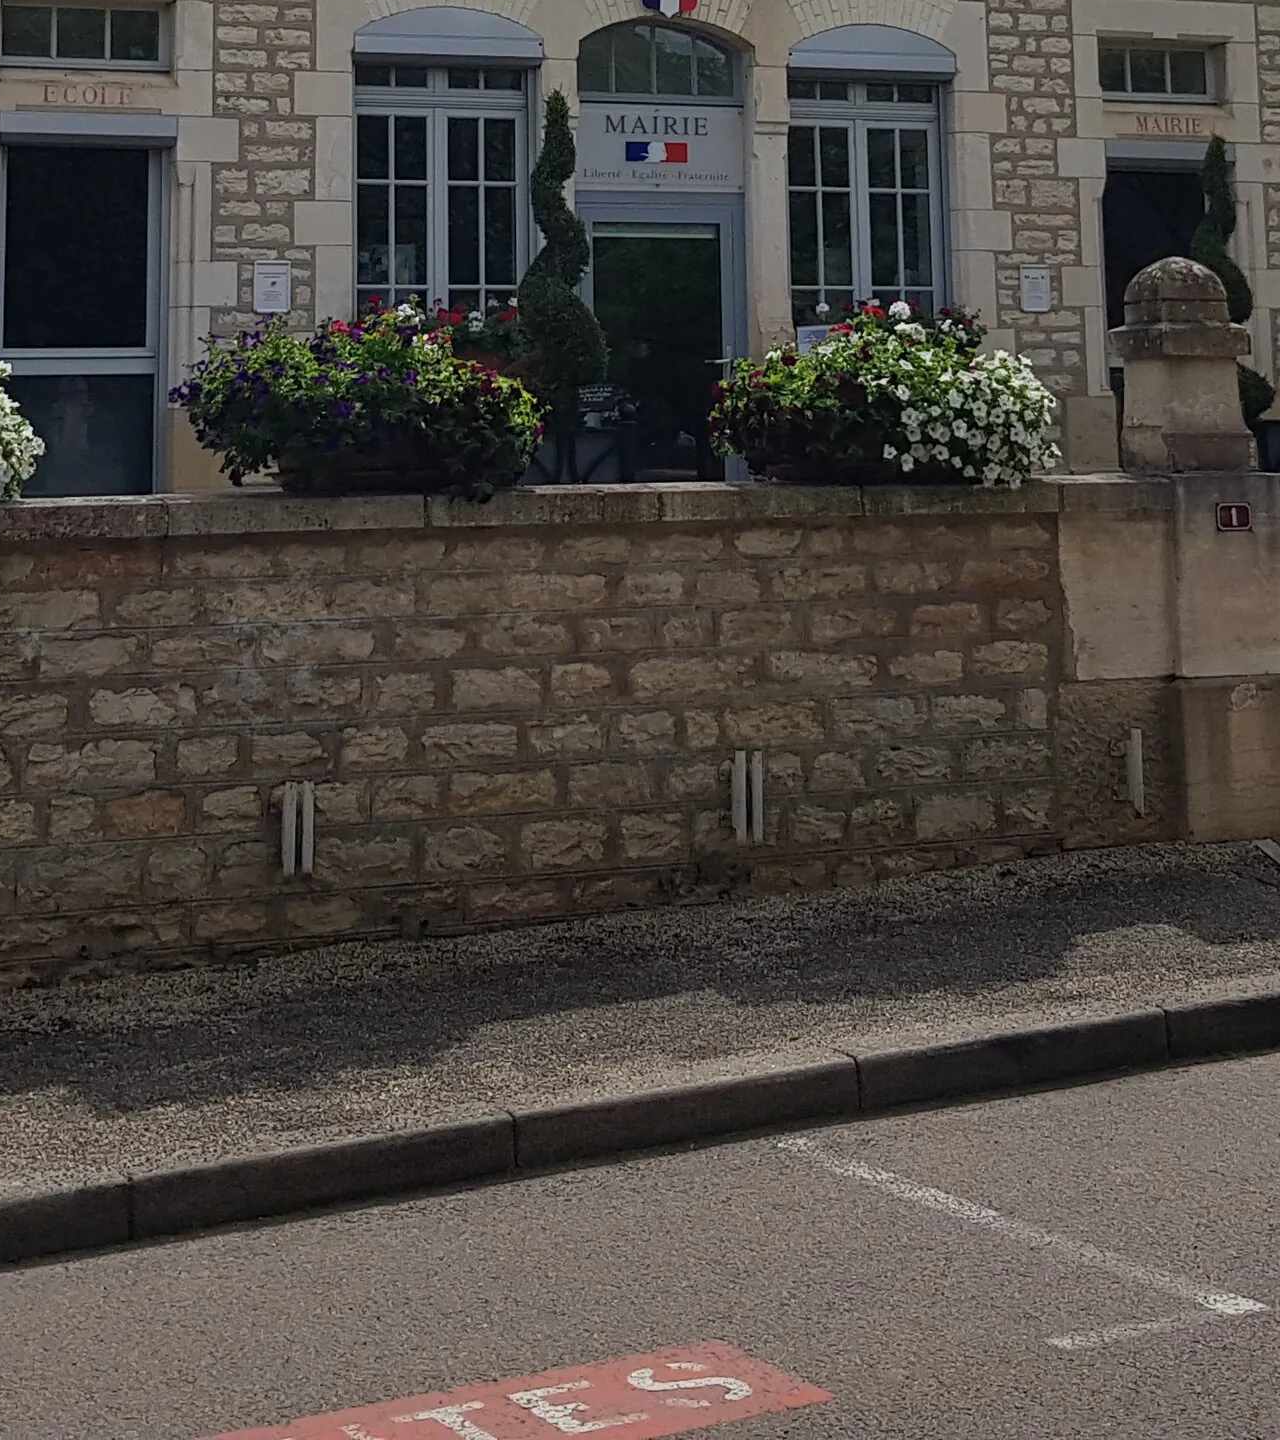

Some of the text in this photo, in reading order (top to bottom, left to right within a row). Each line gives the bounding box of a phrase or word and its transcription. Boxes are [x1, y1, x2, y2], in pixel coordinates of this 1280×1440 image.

[42, 83, 134, 106] ECOLE
[604, 114, 710, 137] MAIRIE
[1135, 115, 1204, 135] MAIRIE
[583, 168, 622, 180] Liberté
[1230, 506, 1239, 527] 1
